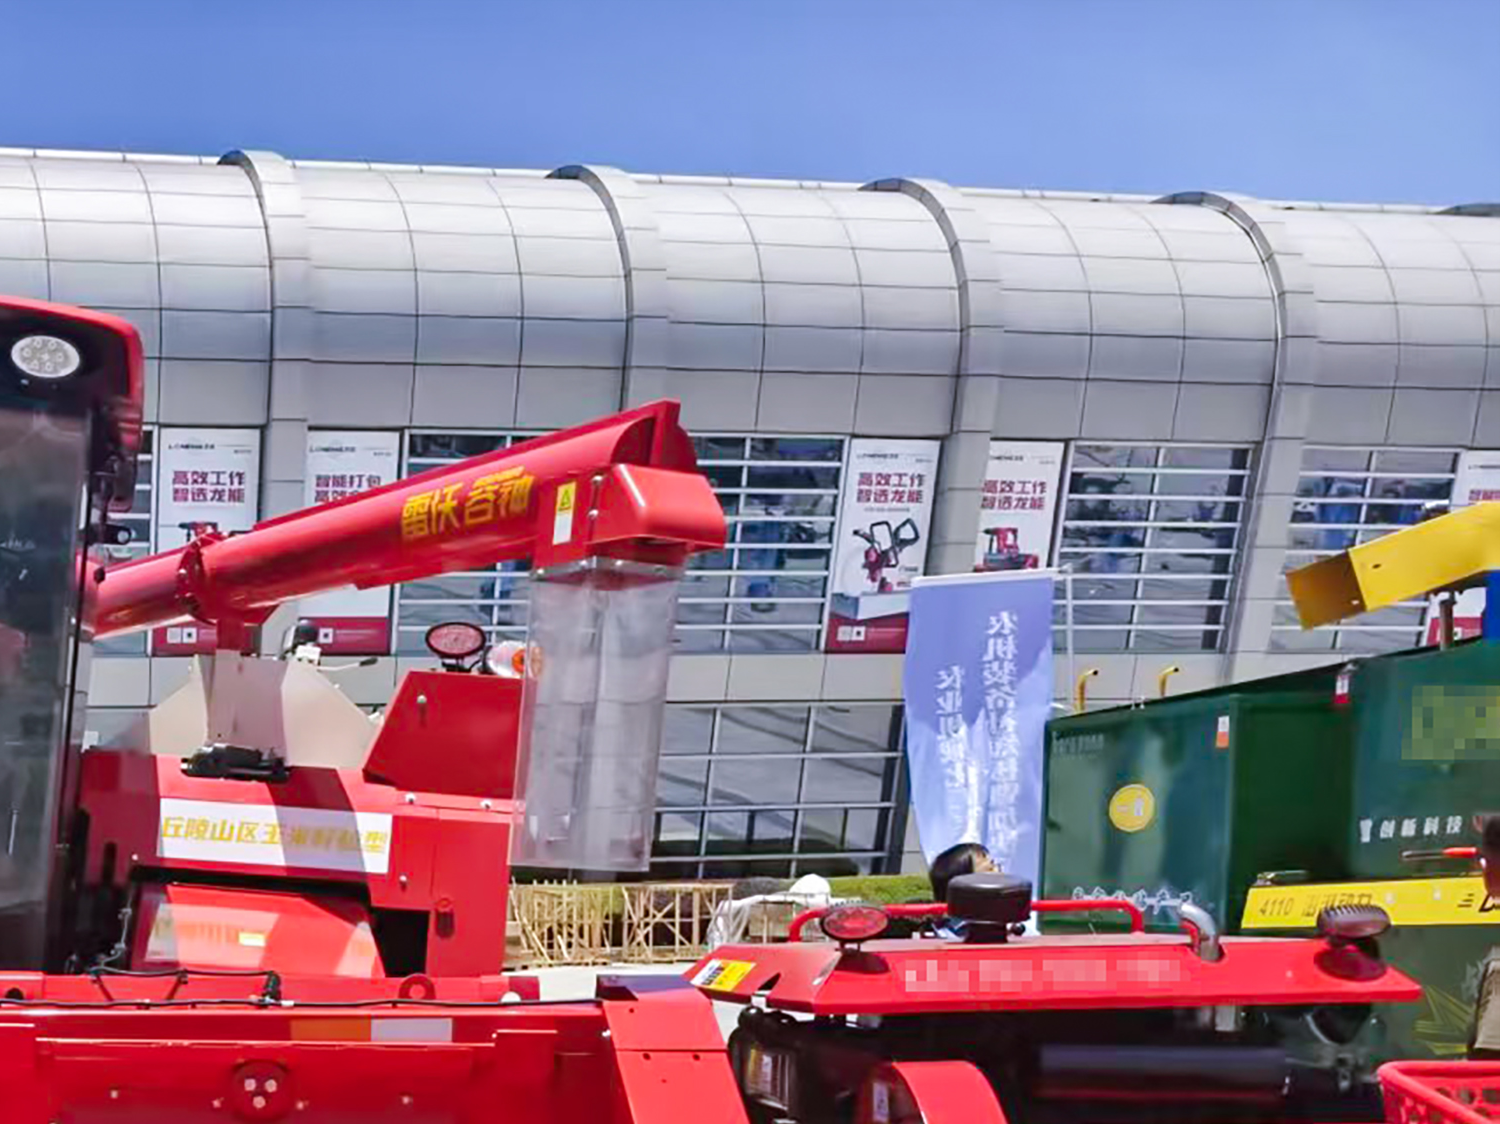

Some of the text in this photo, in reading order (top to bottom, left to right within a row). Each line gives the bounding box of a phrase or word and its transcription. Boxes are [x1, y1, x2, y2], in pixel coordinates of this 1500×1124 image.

[172, 471, 245, 486] 高效工作
[858, 472, 926, 487] 高效工作
[982, 480, 1047, 494] 高效工作
